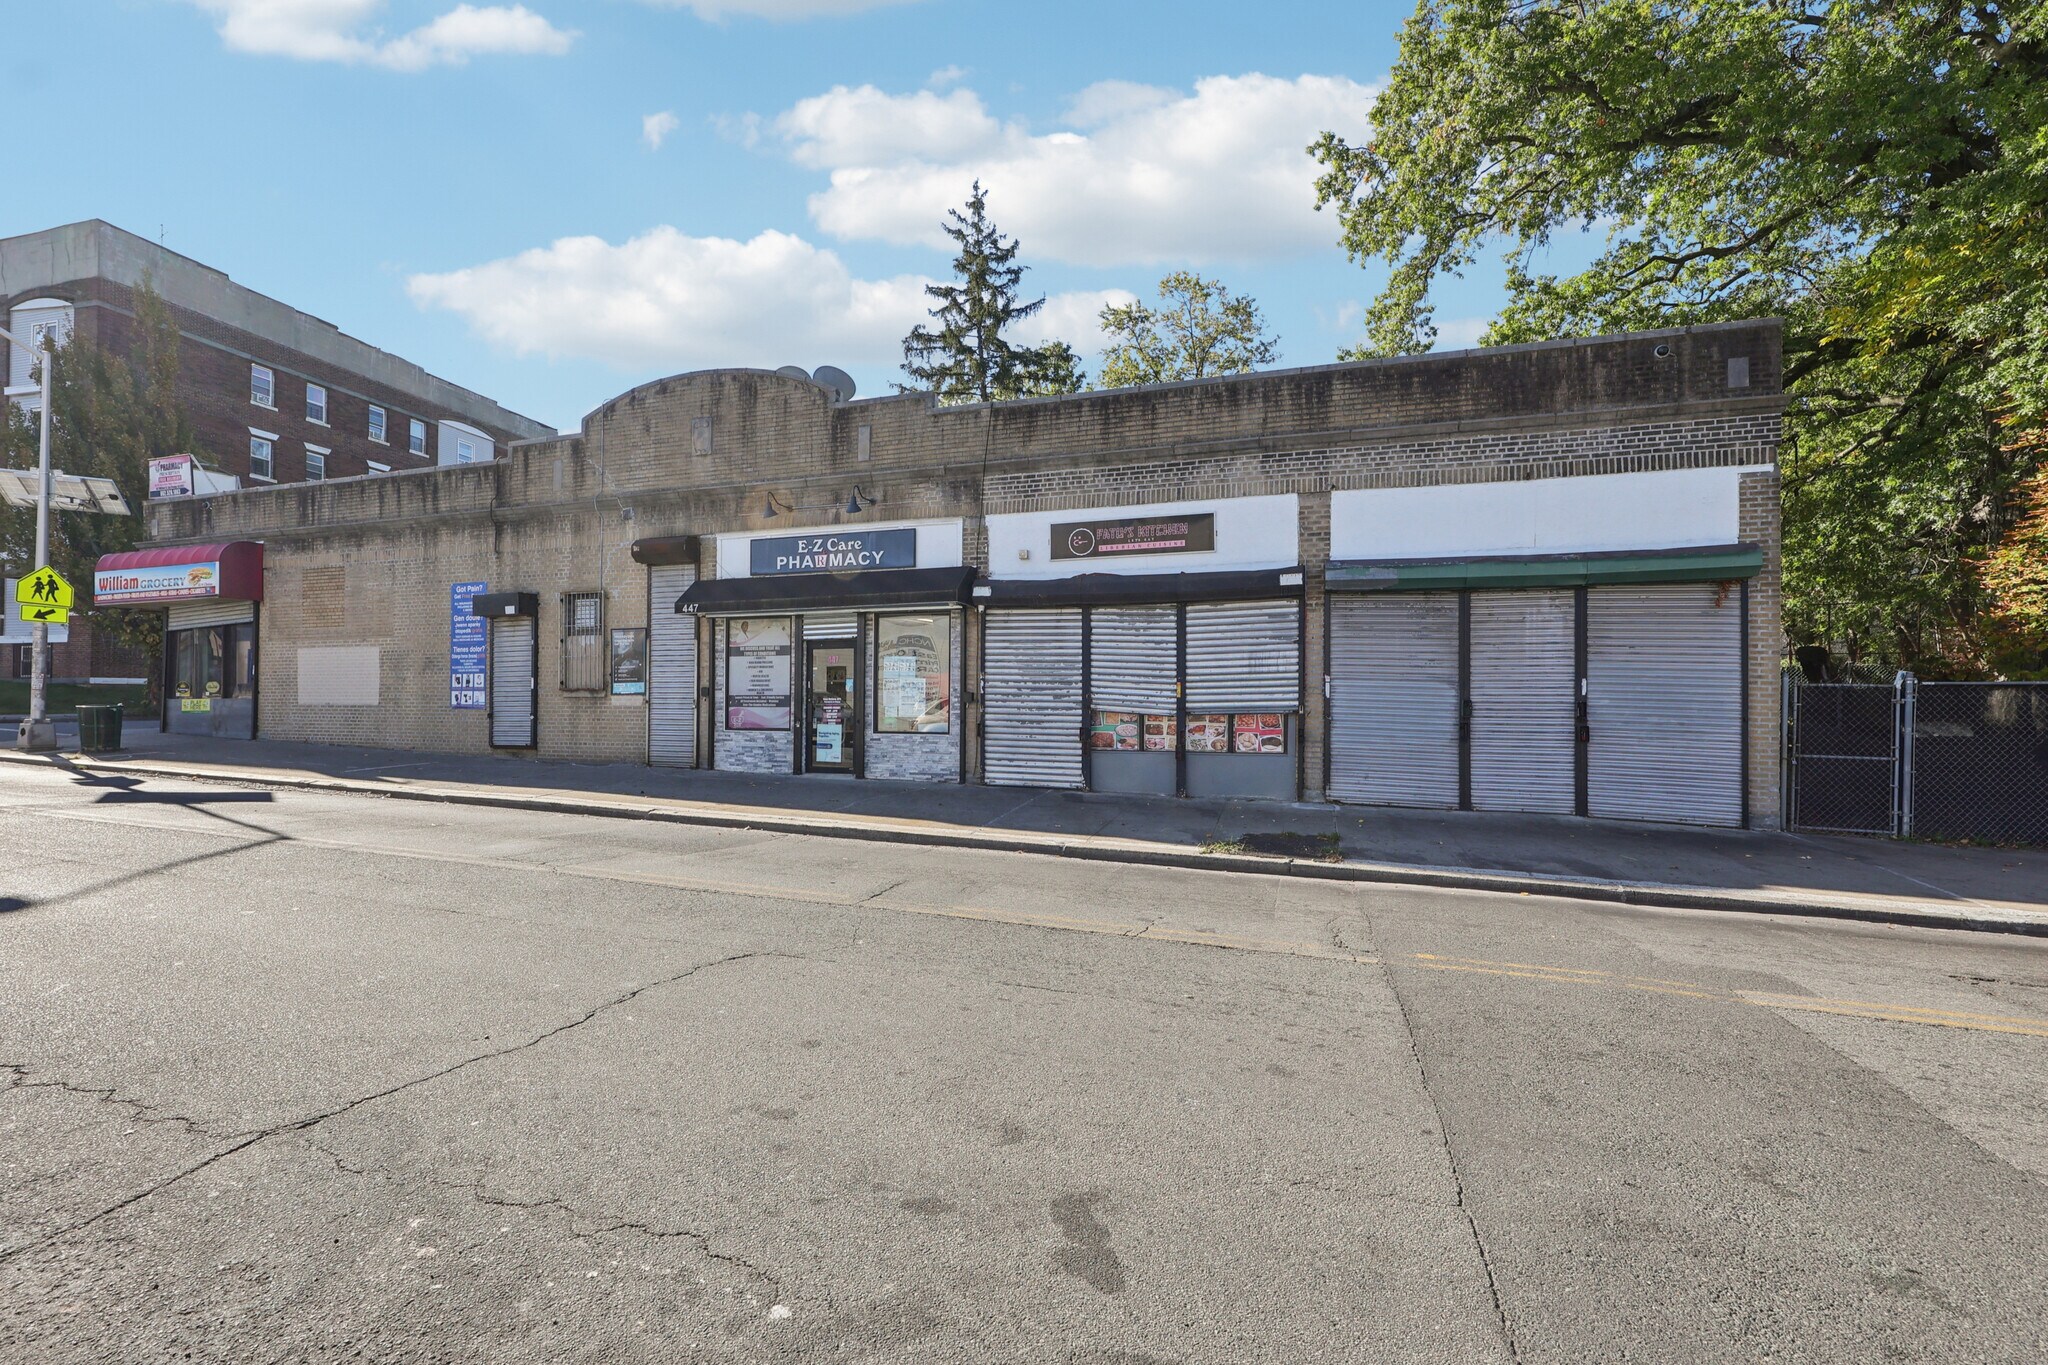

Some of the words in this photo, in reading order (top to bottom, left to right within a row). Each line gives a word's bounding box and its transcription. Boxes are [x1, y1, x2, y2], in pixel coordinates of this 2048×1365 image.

[1137, 522, 1189, 538] KITCHEN
[798, 539, 824, 553] E-Z
[827, 538, 862, 551] Care
[777, 550, 885, 570] PHARMACY
[99, 576, 139, 592] William
[140, 577, 185, 589] GROCERY
[682, 603, 699, 613] 447
